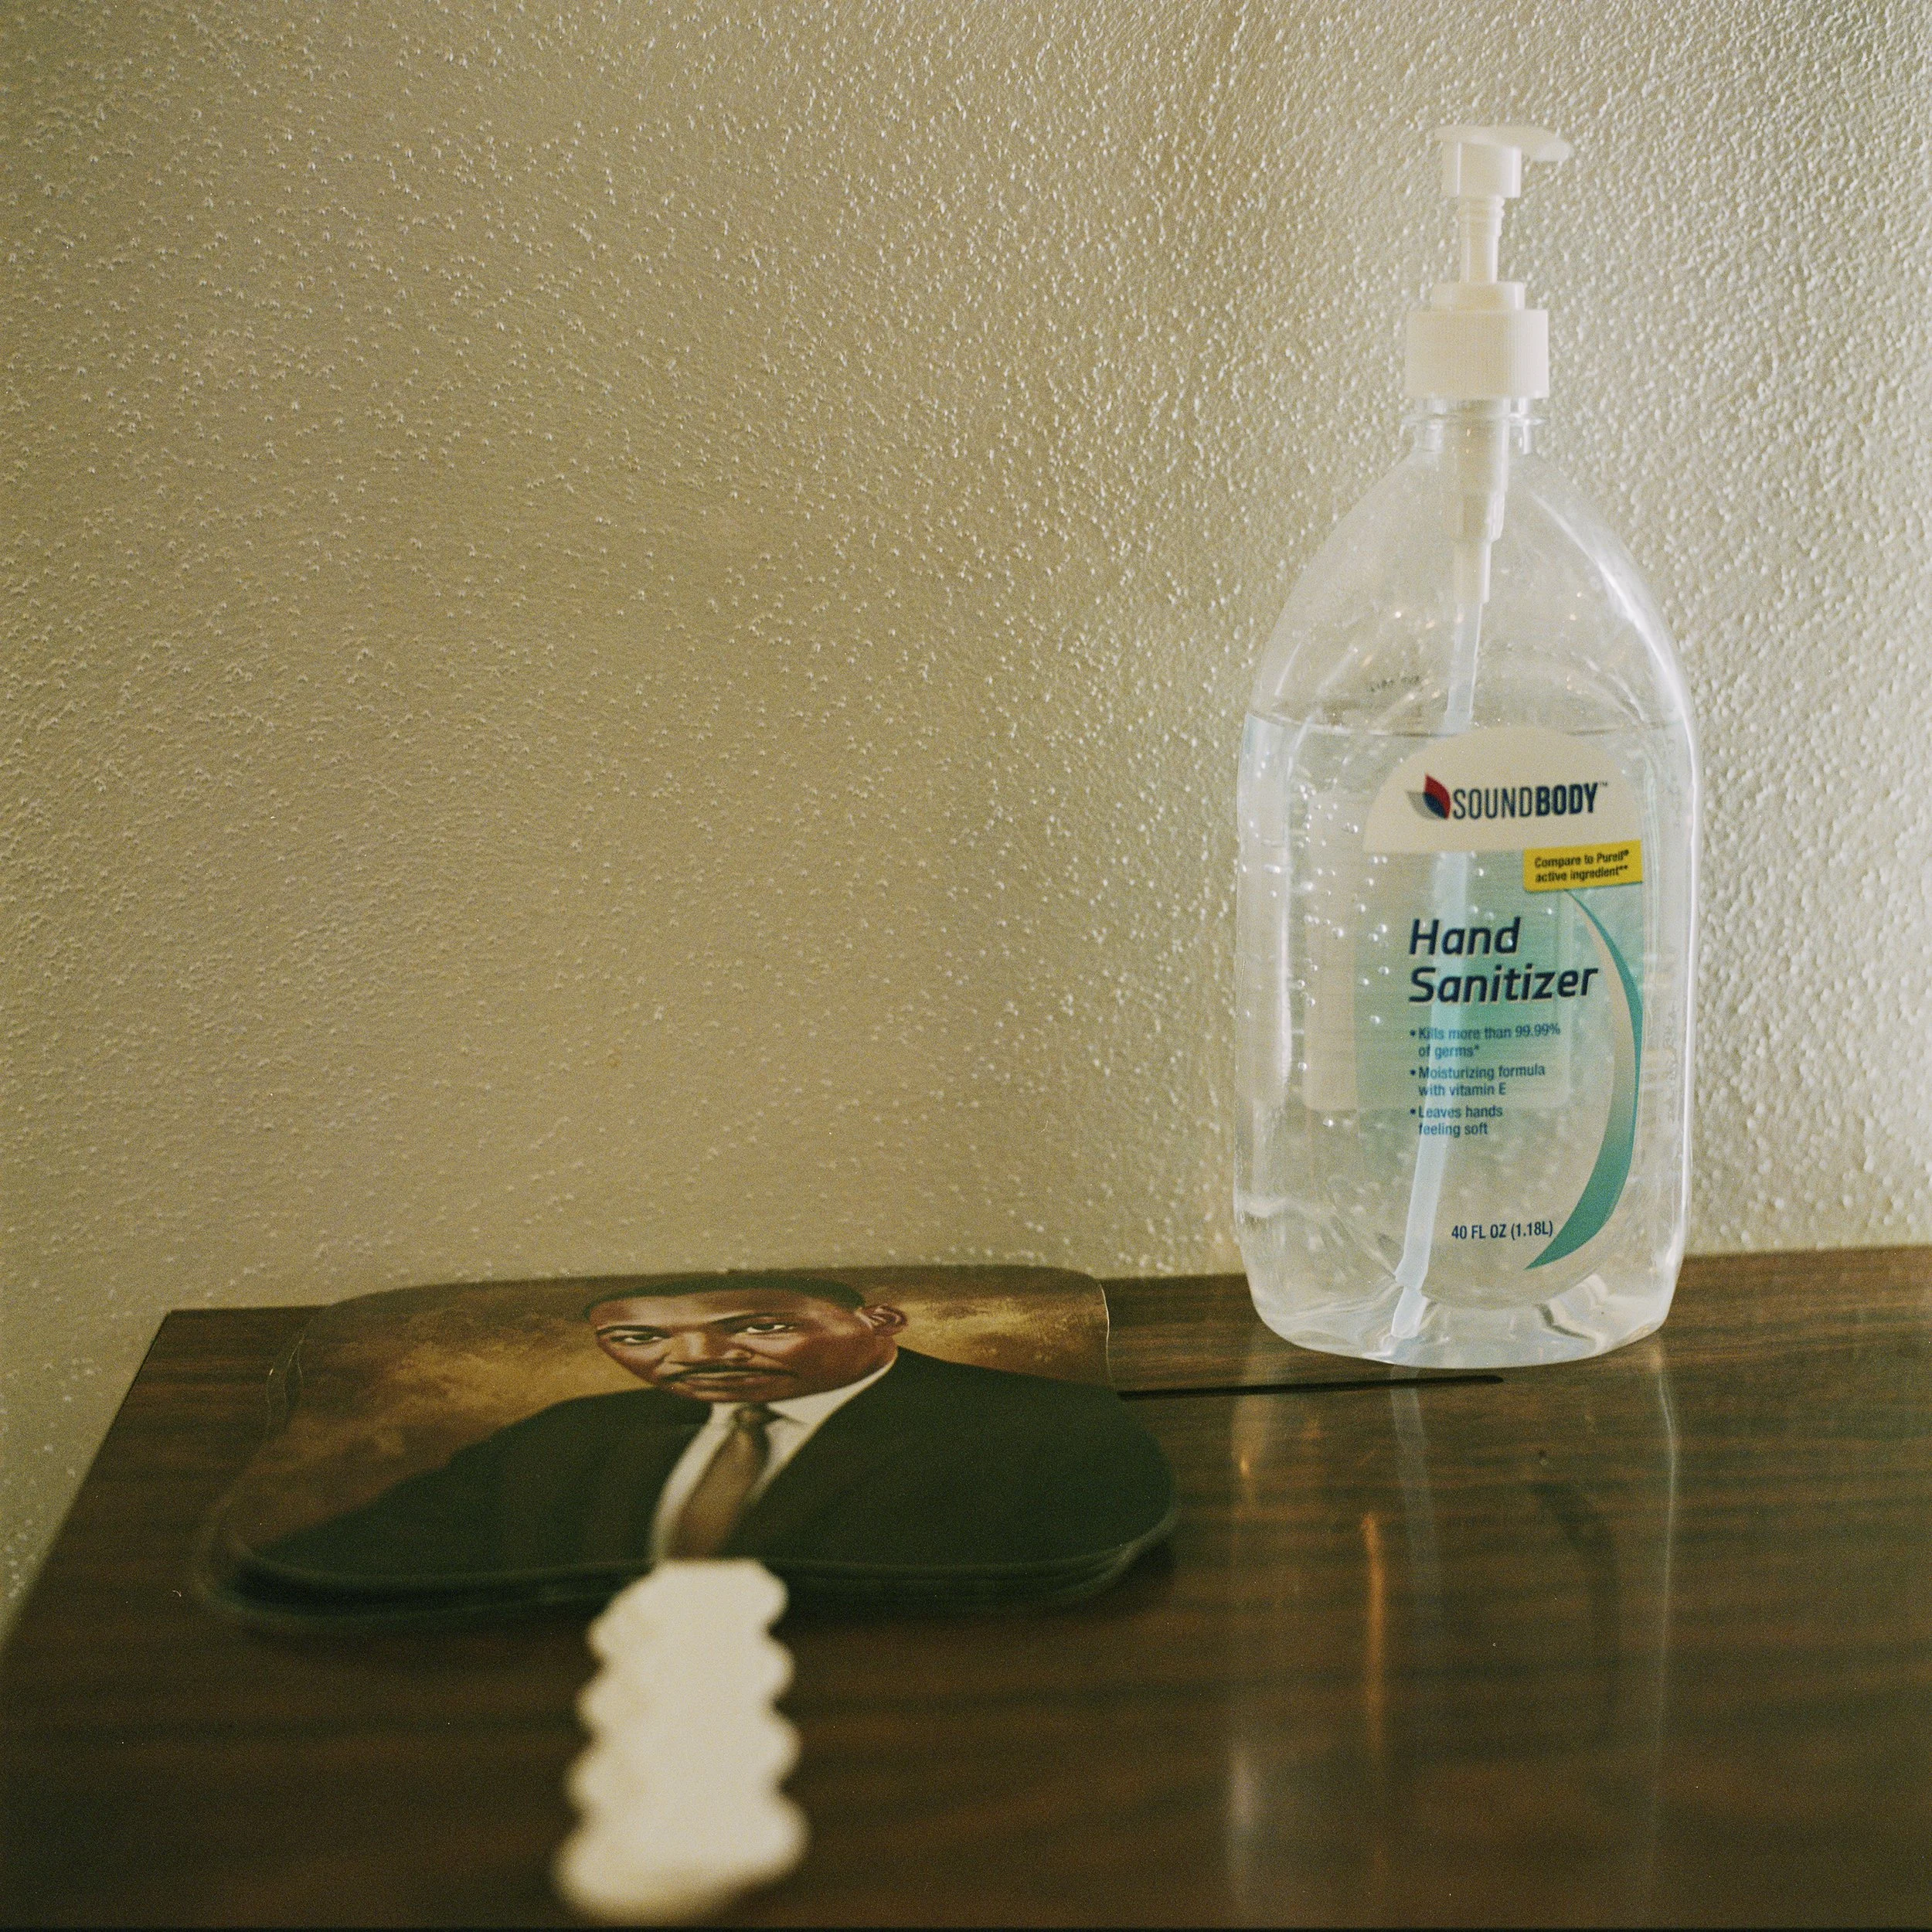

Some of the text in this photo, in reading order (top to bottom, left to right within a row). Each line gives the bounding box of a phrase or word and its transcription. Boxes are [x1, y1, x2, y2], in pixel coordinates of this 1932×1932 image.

[1534, 855, 1581, 869] Compare
[1585, 855, 1594, 864] to
[1535, 870, 1566, 883] active
[1409, 917, 1521, 955] Hand
[1409, 963, 1599, 1003] Sanitizer
[1417, 1022, 1560, 1039] Kills more than 99.99%
[1418, 1045, 1430, 1057] of
[1418, 1063, 1546, 1081] Moisturizing formula
[1418, 1083, 1506, 1096] with vitamin E
[1417, 1105, 1503, 1118] Leaves hands
[1419, 1122, 1488, 1137] feeling soft
[1451, 1220, 1553, 1240] 40 FL OZ (1.18L)
